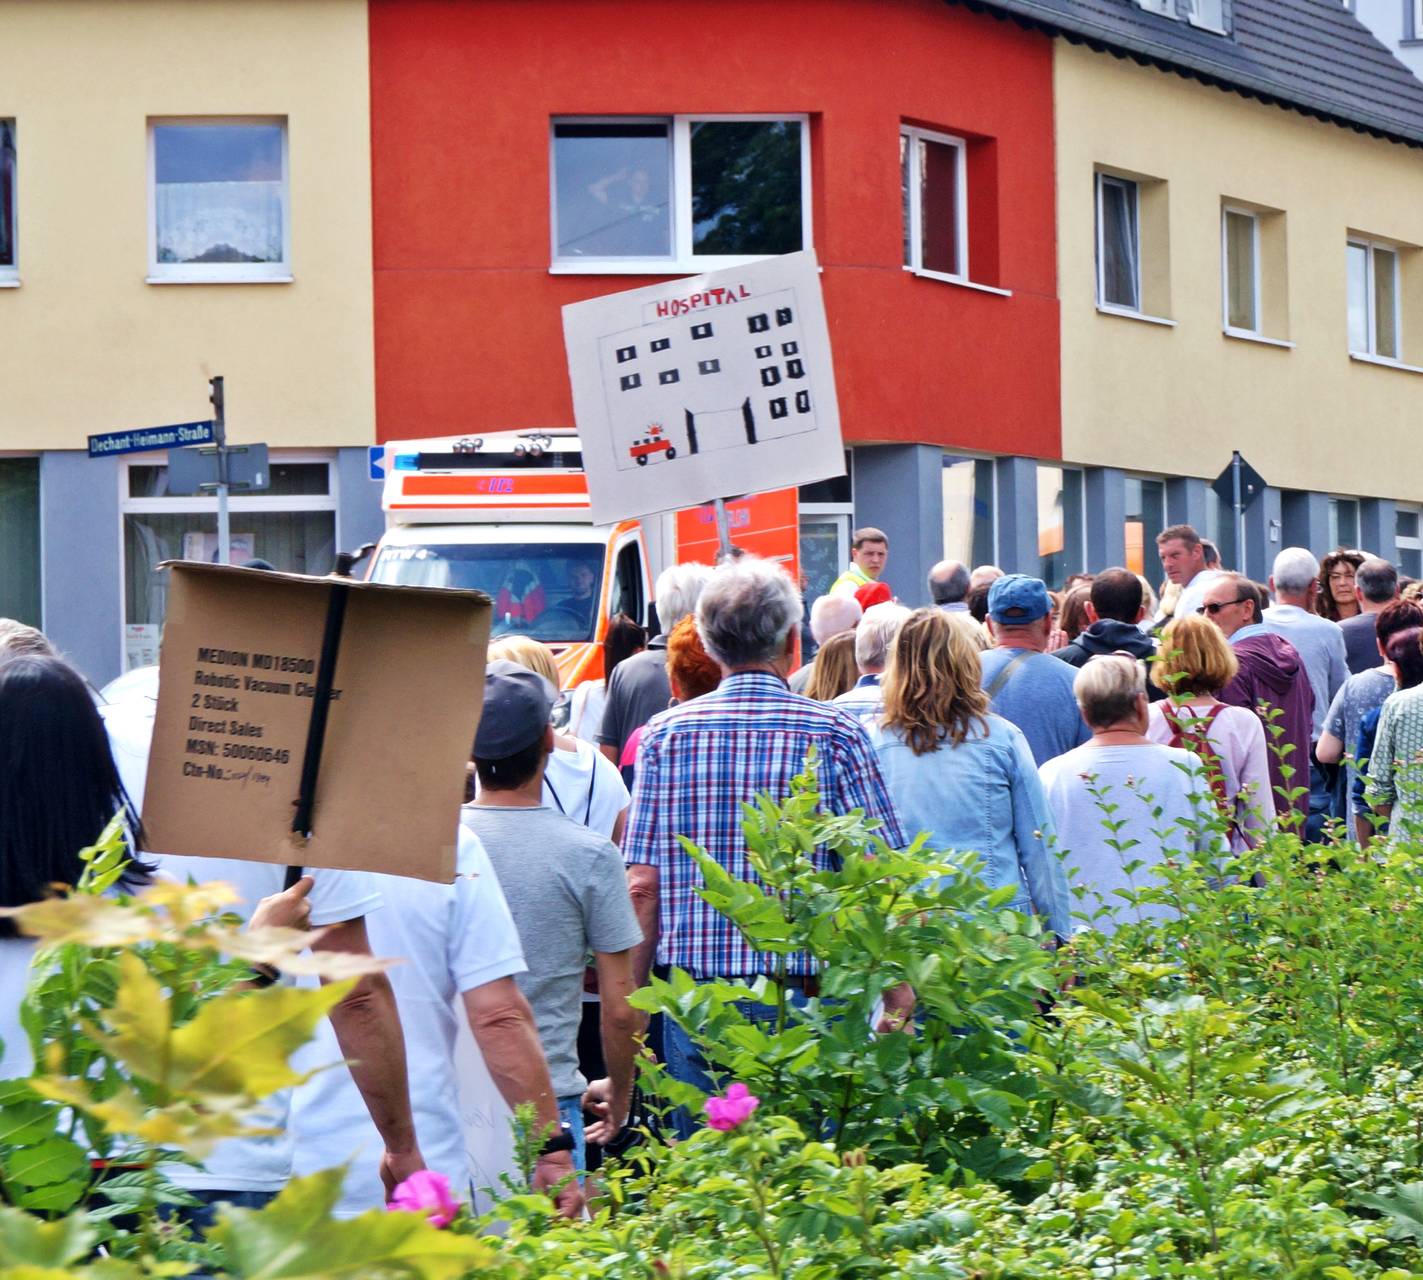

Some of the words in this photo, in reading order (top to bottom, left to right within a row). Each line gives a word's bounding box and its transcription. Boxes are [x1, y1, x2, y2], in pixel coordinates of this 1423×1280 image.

[657, 284, 751, 318] HOSPITAL
[90, 425, 209, 452] Dechant-Heimann-Straße
[197, 648, 248, 668] MEDION
[252, 653, 315, 674] MD18500
[194, 671, 240, 690] Robotic
[244, 676, 291, 696] Vacuum
[295, 682, 343, 700] Cleer
[191, 693, 201, 708] 2
[203, 694, 239, 713] Stück
[188, 716, 226, 735] Direct
[229, 720, 264, 738] Sales
[185, 738, 219, 756] MSN:
[222, 743, 290, 764] 50060646
